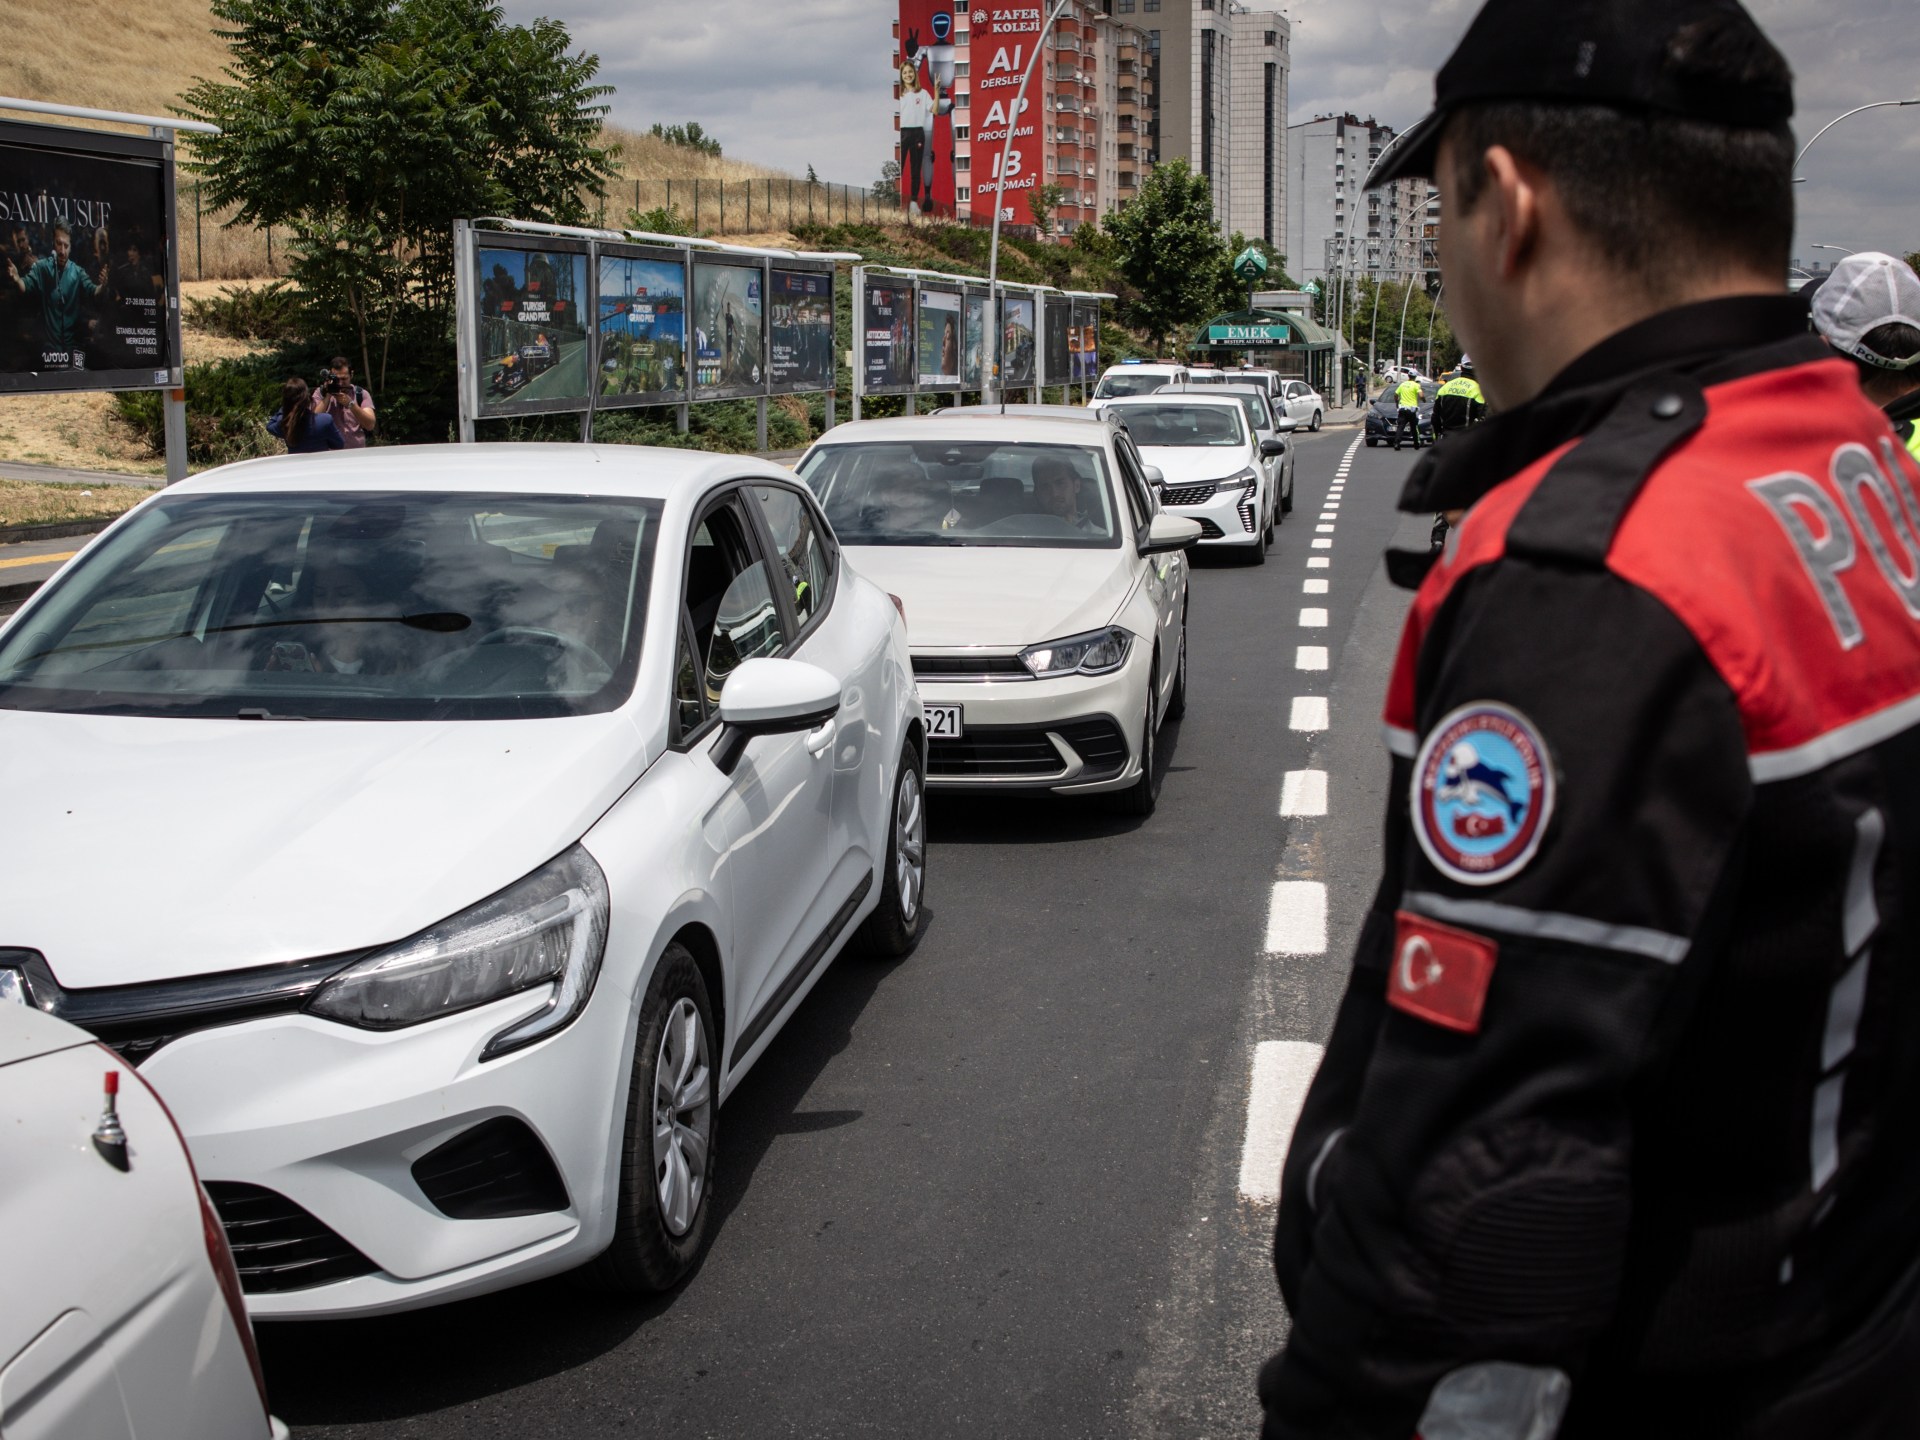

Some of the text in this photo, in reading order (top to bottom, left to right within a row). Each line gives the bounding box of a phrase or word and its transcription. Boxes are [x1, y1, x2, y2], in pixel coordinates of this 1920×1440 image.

[992, 8, 1040, 21] ZAFER
[992, 19, 1041, 33] KOLEJİ
[987, 44, 1022, 74] AI
[980, 74, 1027, 89] DERSLER
[982, 98, 1029, 128] AP
[977, 126, 1034, 142] PROGAMI
[991, 150, 1022, 179] IB
[50, 196, 112, 229] YUSUF
[522, 301, 547, 311] TURKISH
[632, 304, 653, 313] TURKISH
[517, 311, 551, 322] GRAND PRIX
[1228, 327, 1271, 338] EMEK
[924, 709, 955, 734] 521
